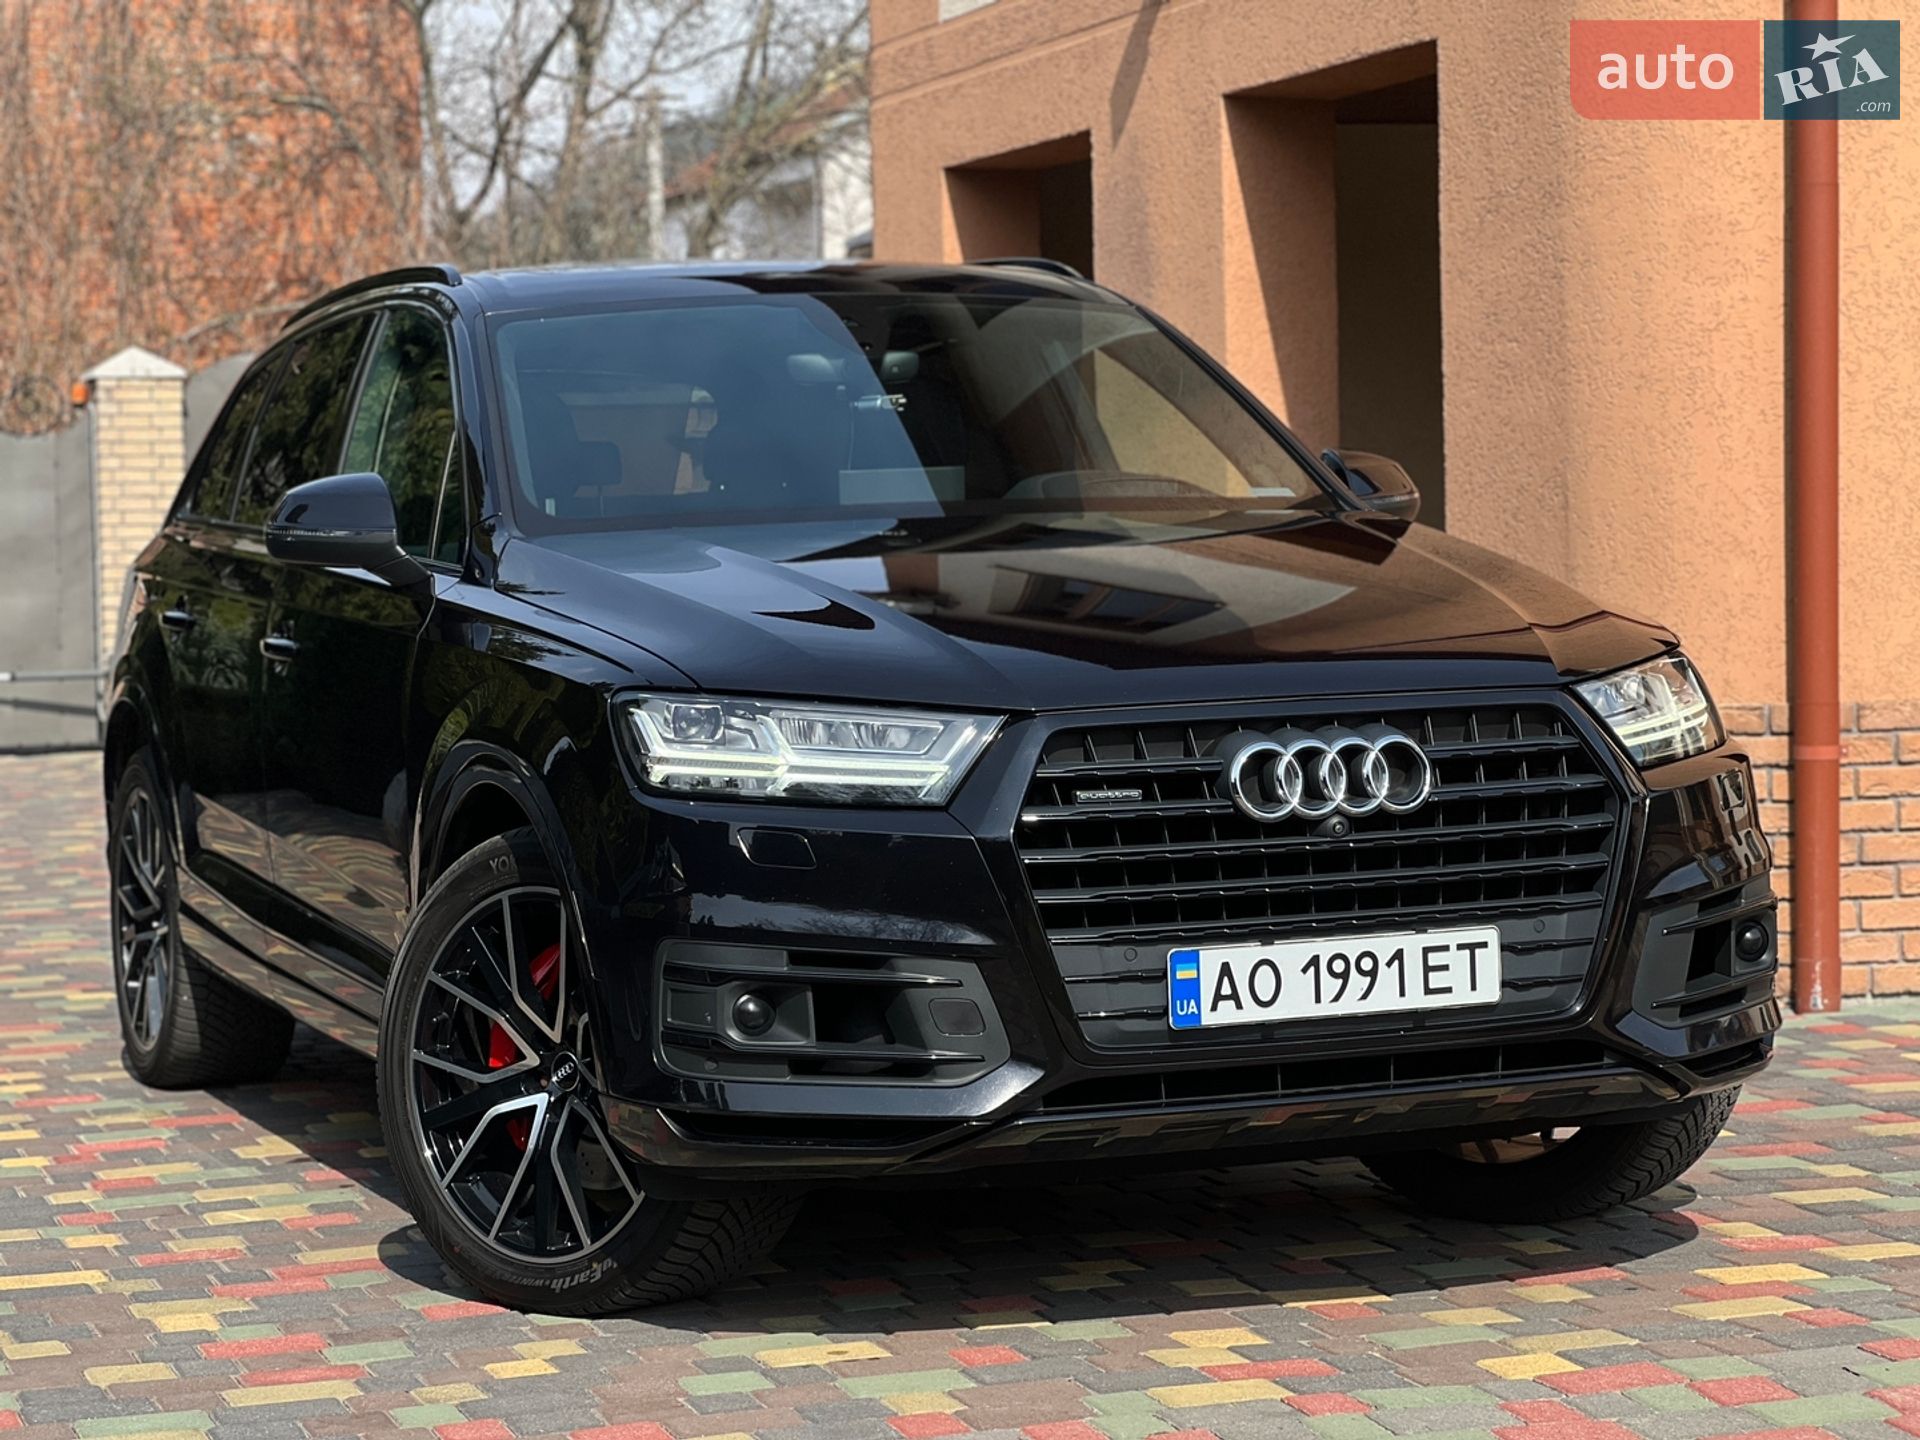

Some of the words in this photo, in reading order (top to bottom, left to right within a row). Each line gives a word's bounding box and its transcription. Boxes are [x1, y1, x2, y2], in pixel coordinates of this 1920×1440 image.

[1209, 957, 1283, 1012] AO
[1300, 949, 1406, 1005] 1991
[1422, 941, 1489, 997] ET
[1176, 998, 1199, 1016] UA
